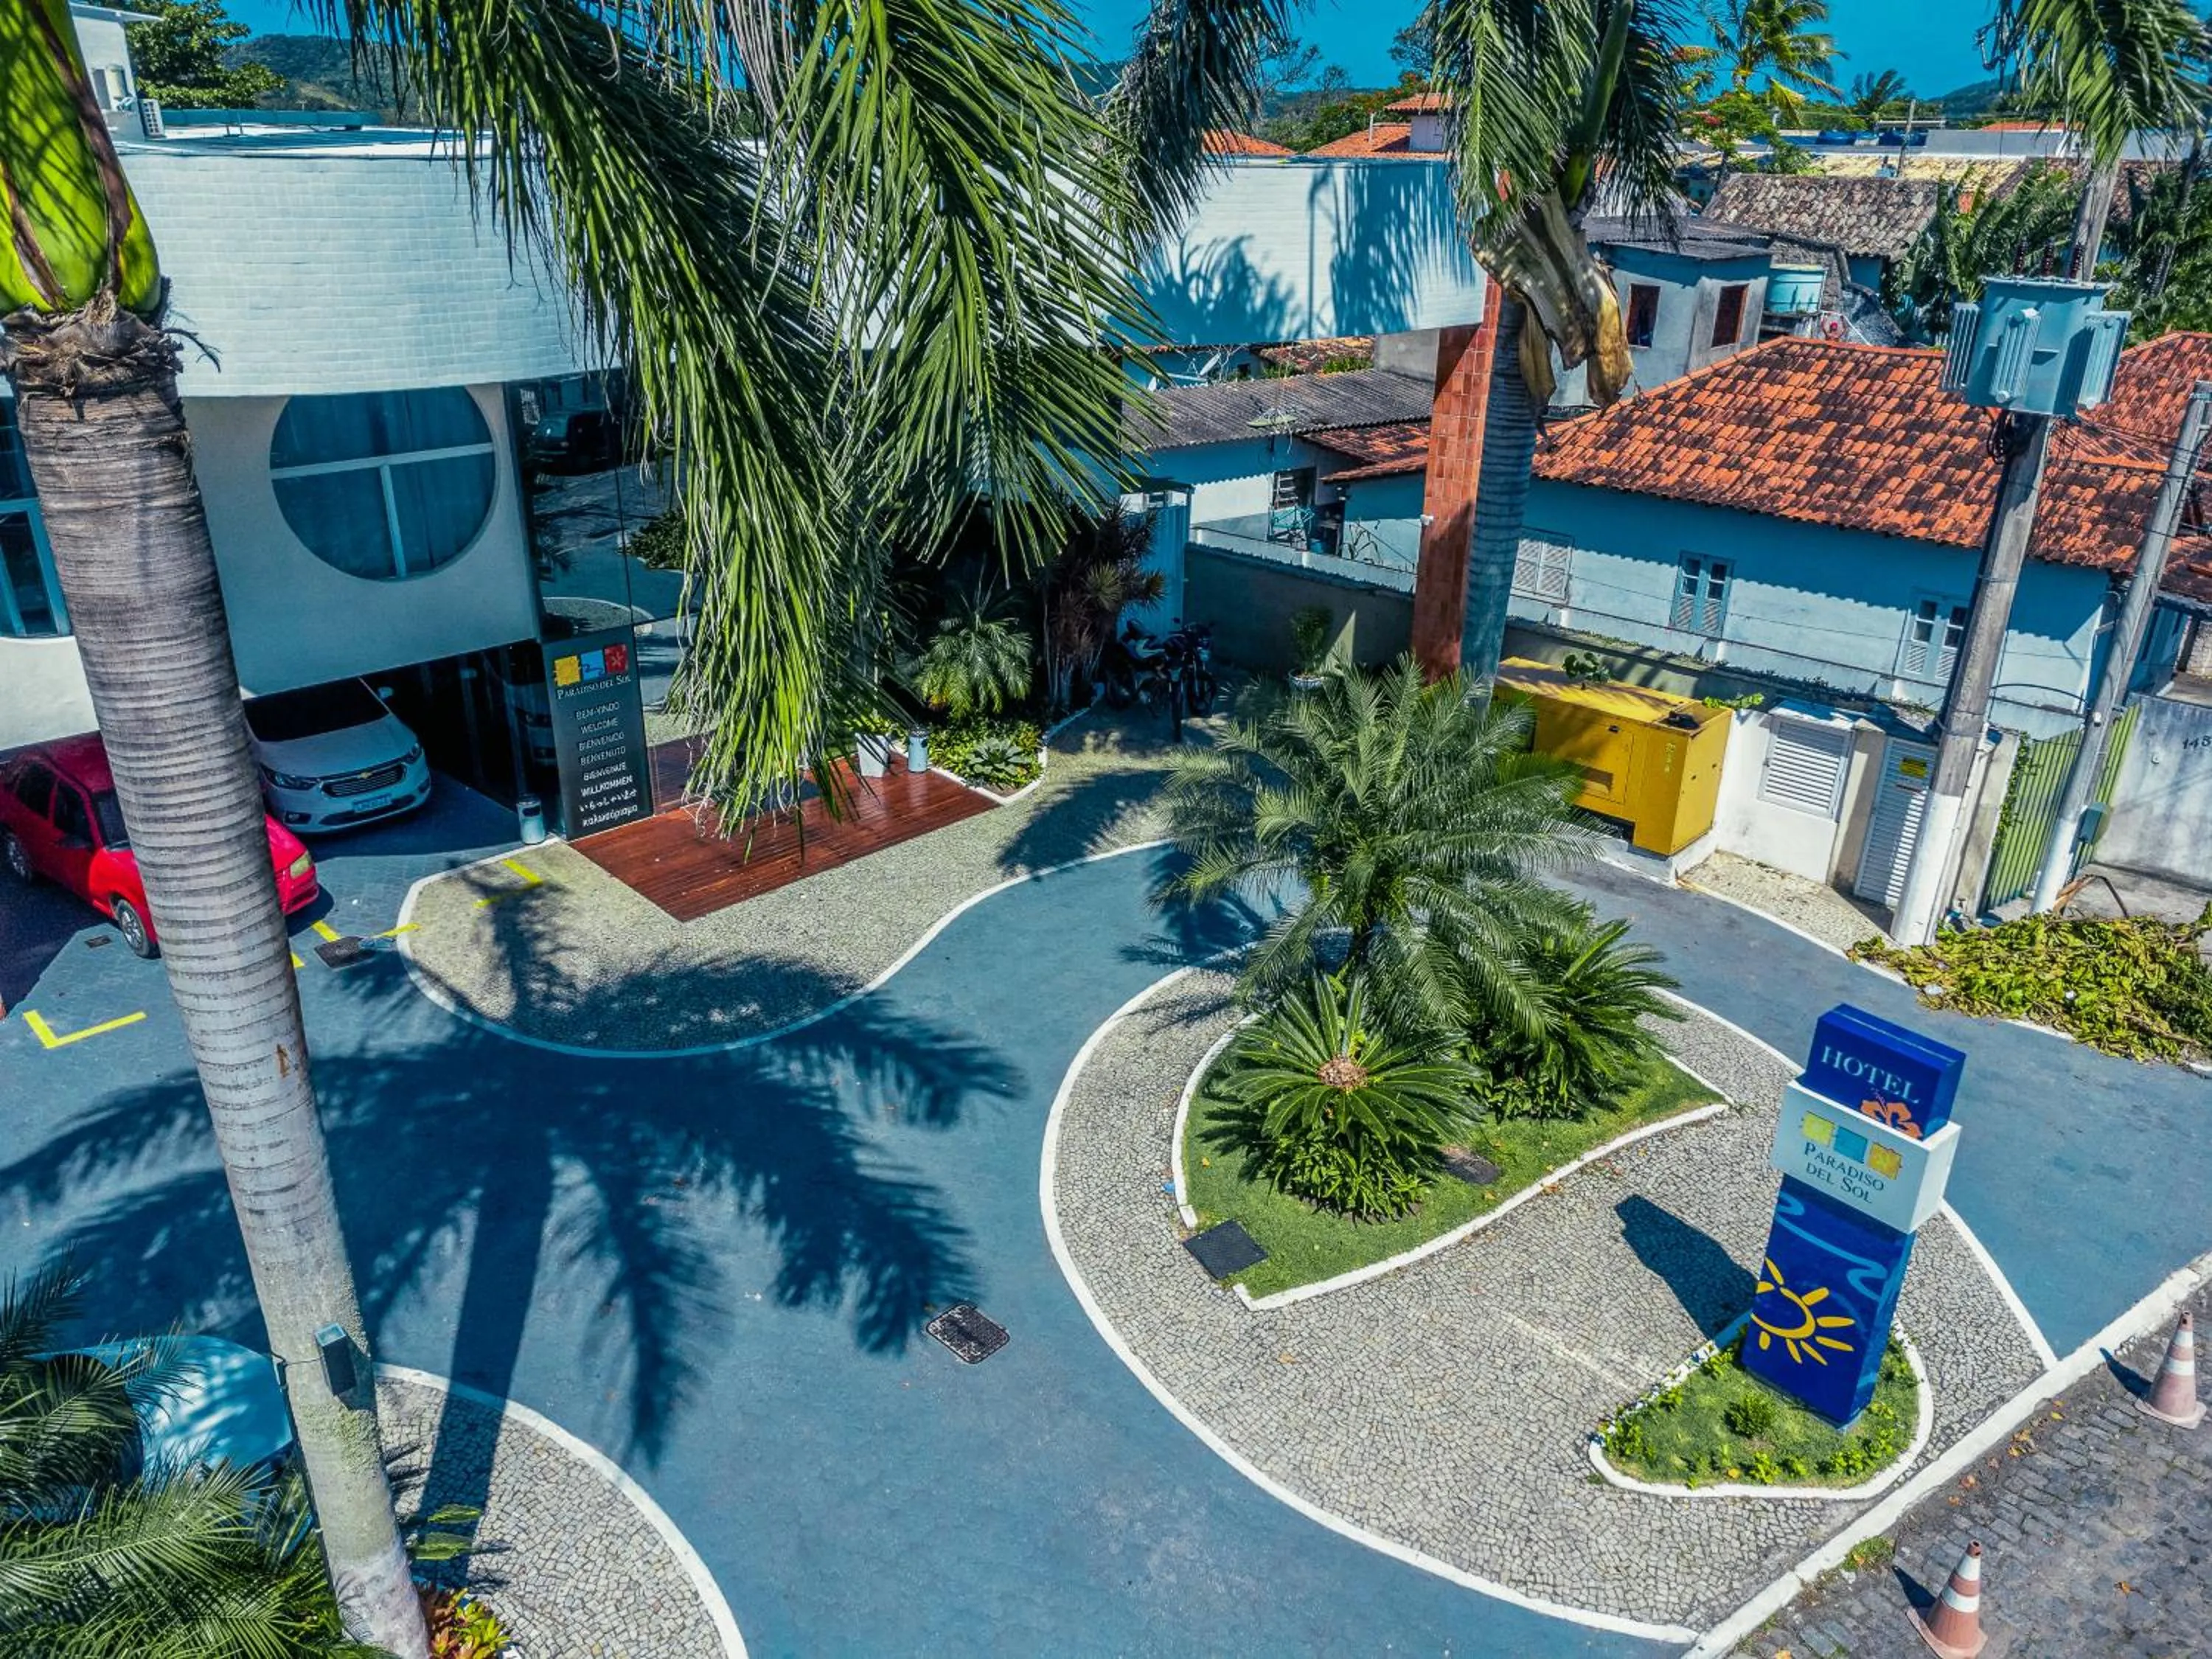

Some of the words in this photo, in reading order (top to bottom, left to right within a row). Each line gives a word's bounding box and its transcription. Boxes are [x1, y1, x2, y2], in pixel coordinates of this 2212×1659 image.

[580, 717, 619, 734] WELCOME
[580, 775, 633, 797] WILLKOMMEN
[1820, 1046, 1920, 1104] HOTEL
[1804, 1141, 1885, 1192] PARADISO
[1806, 1162, 1834, 1185] DEL
[1840, 1177, 1873, 1204] SOL
